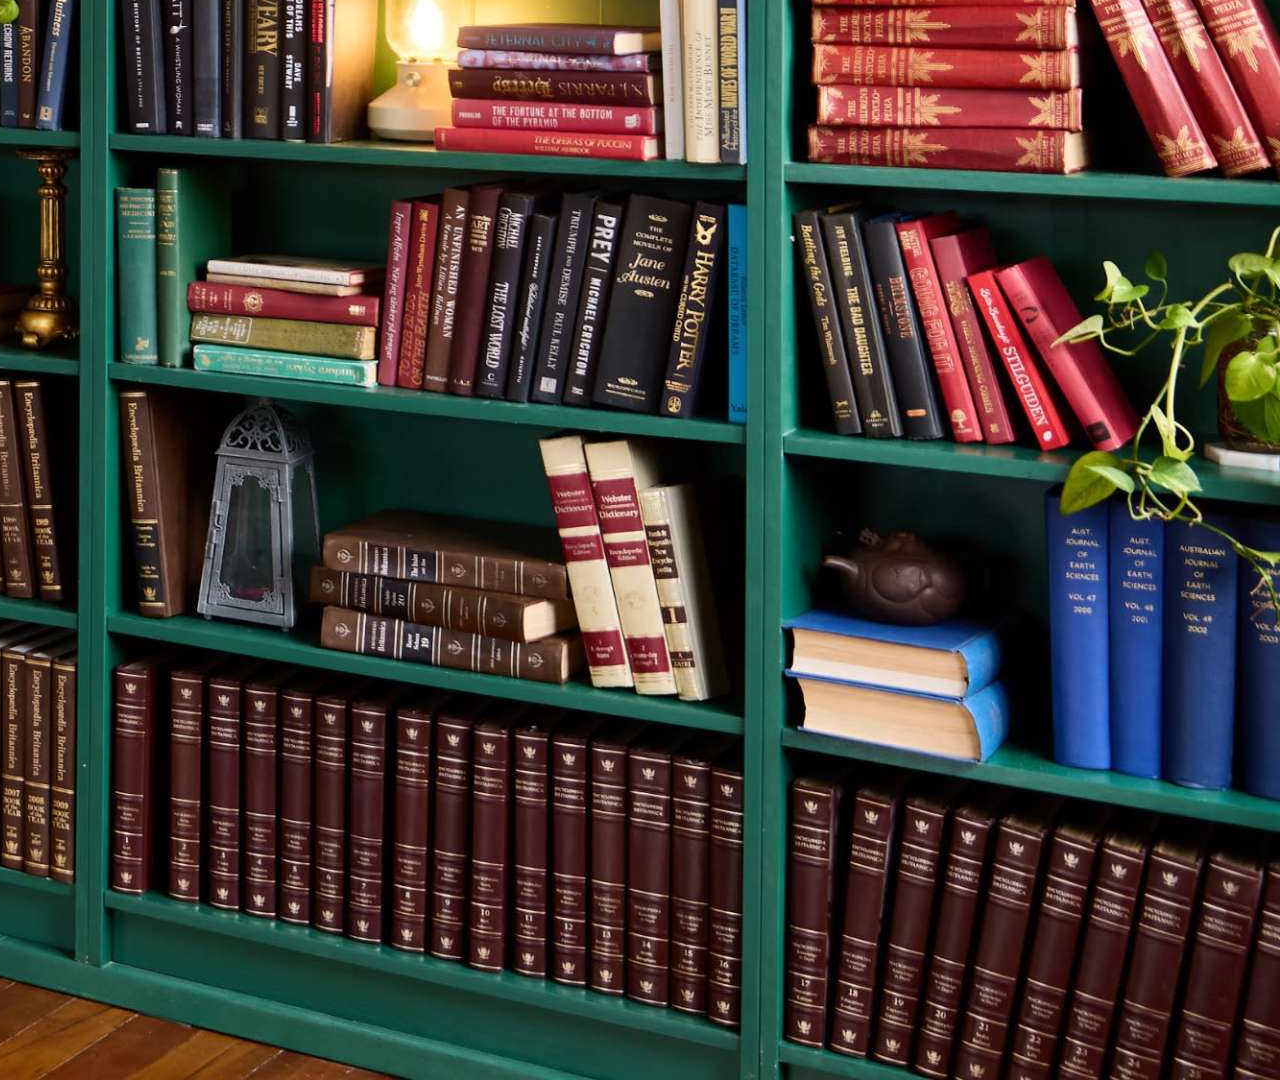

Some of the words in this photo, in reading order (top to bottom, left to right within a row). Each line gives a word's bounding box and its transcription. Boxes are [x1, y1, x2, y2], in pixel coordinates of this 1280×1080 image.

[295, 0, 303, 32] DREAMS
[286, 17, 294, 39] THIS
[19, 26, 33, 83] ABANDON
[3, 50, 13, 83] RETURNS
[285, 55, 294, 90] STEWART
[492, 106, 508, 115] THE
[510, 107, 545, 117] FORTUNE
[562, 108, 577, 118] THE
[579, 109, 613, 119] BOTTOM
[522, 118, 558, 129] PYRAMID
[550, 136, 585, 146] OPERAS
[597, 139, 632, 149] PUCCINI
[566, 209, 581, 253] TRIUMPH
[591, 214, 617, 263] PREY
[635, 232, 673, 244] COMPLETE
[633, 240, 661, 251] NOVELS
[801, 224, 816, 265] Battling
[447, 226, 465, 295] UNFINISHED
[629, 253, 666, 270] Jane
[838, 242, 853, 276] FIELDING
[558, 268, 571, 305] DEMISE
[617, 270, 671, 290] Austen
[689, 250, 715, 306] HARRY
[494, 282, 509, 299] THE
[584, 277, 602, 321] MICHAEL
[846, 286, 858, 305] THE
[490, 299, 506, 326] LOST
[851, 306, 862, 325] BAD
[889, 277, 913, 338] BRIMSTONE
[443, 300, 455, 338] WOMAN
[554, 312, 565, 336] PAUL
[486, 327, 503, 370] WORLD
[576, 323, 594, 376] CRICHTON
[676, 310, 705, 370] POTTER
[854, 326, 873, 375] DAUGHTER
[547, 338, 561, 370] KELLY
[134, 465, 145, 512] Britannica
[601, 494, 632, 502] Webster
[554, 504, 593, 514] Dictionary
[599, 508, 639, 519] Dictionary
[1066, 538, 1099, 547] JOURNAL
[1123, 547, 1157, 557] JOURNAL
[1179, 545, 1226, 556] AUSTRALIAN
[1184, 559, 1218, 568] JOURNAL
[1065, 572, 1100, 581] SCIENCES
[1122, 581, 1157, 591] SCIENCES
[1127, 571, 1152, 579] EARTH
[1186, 581, 1210, 590] EARTH
[1180, 591, 1216, 601] SCIENCES
